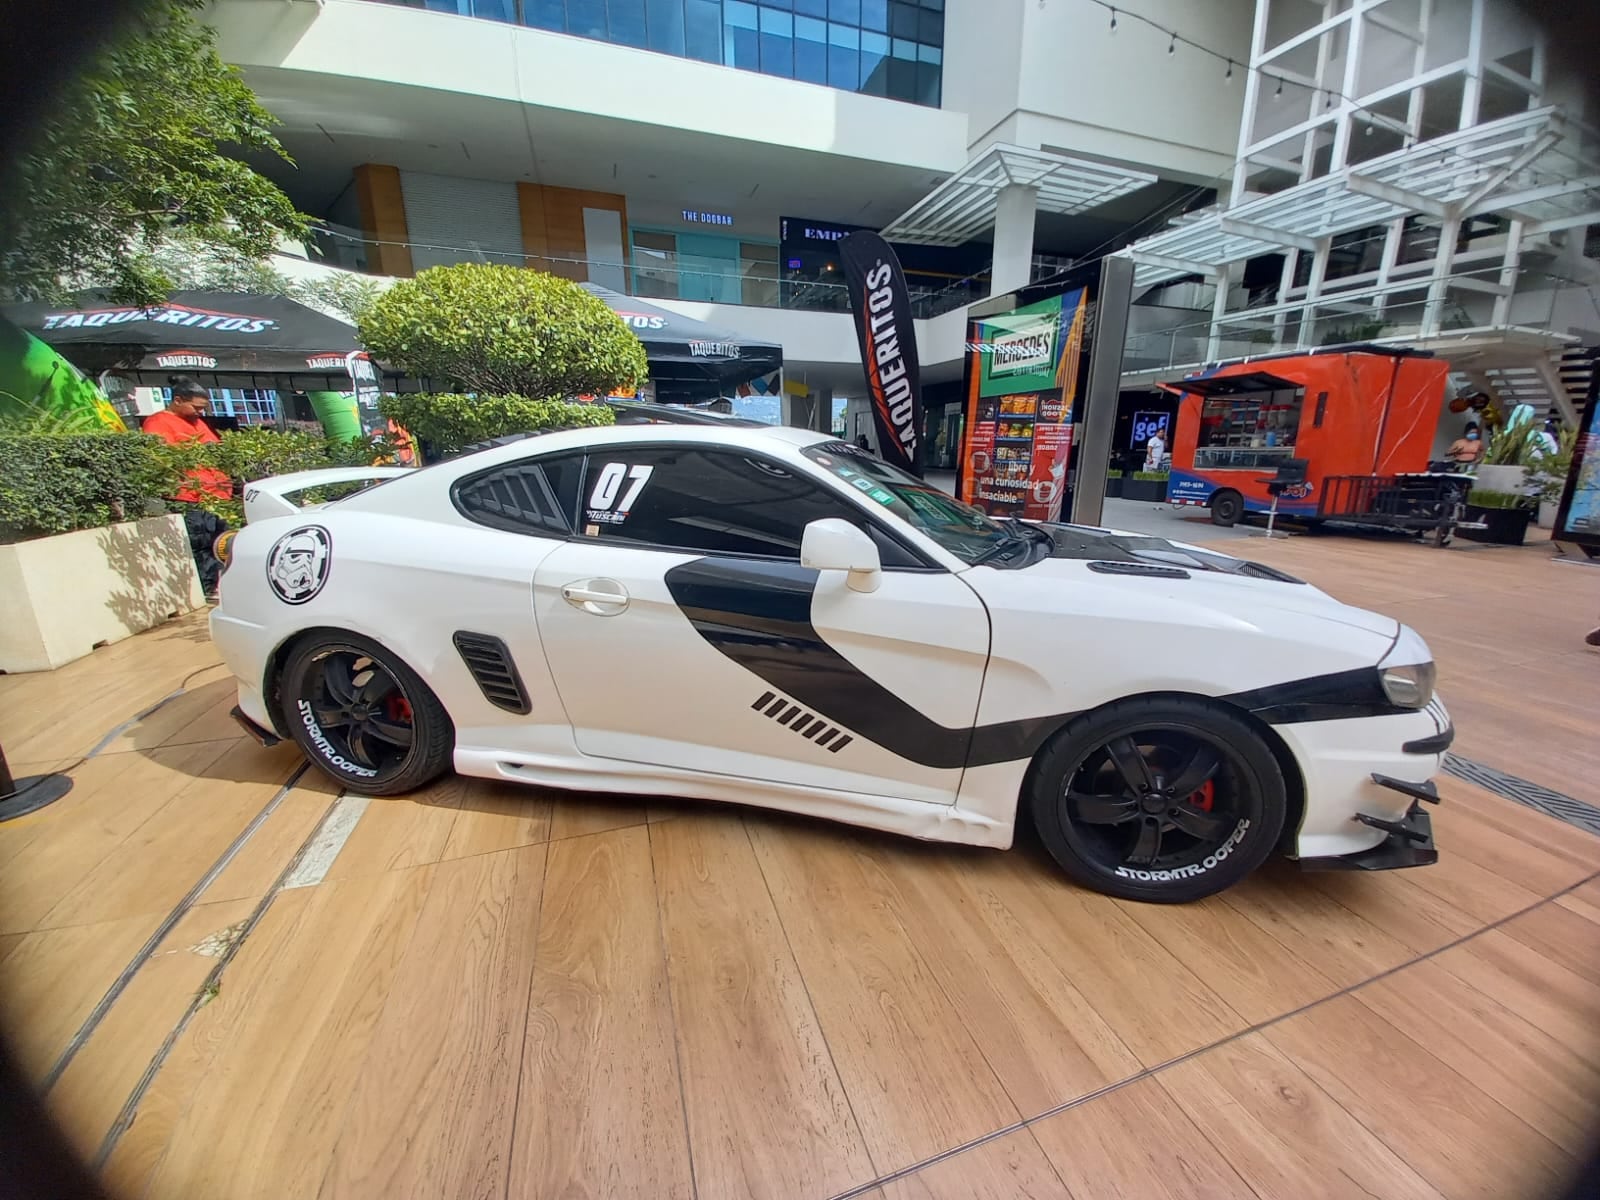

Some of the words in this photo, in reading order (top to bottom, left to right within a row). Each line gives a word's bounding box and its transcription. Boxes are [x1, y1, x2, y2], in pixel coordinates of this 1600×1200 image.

[682, 211, 698, 222] THE
[43, 308, 274, 333] TAQUERITOS
[689, 343, 741, 359] TAQUERITOS
[156, 355, 217, 369] TAQUERITOS
[590, 462, 654, 512] 07
[995, 477, 1039, 489] curiosidad
[245, 489, 260, 503] 07
[297, 699, 378, 777] STORMTROOPER
[1115, 818, 1250, 881] STORMTROOPER
